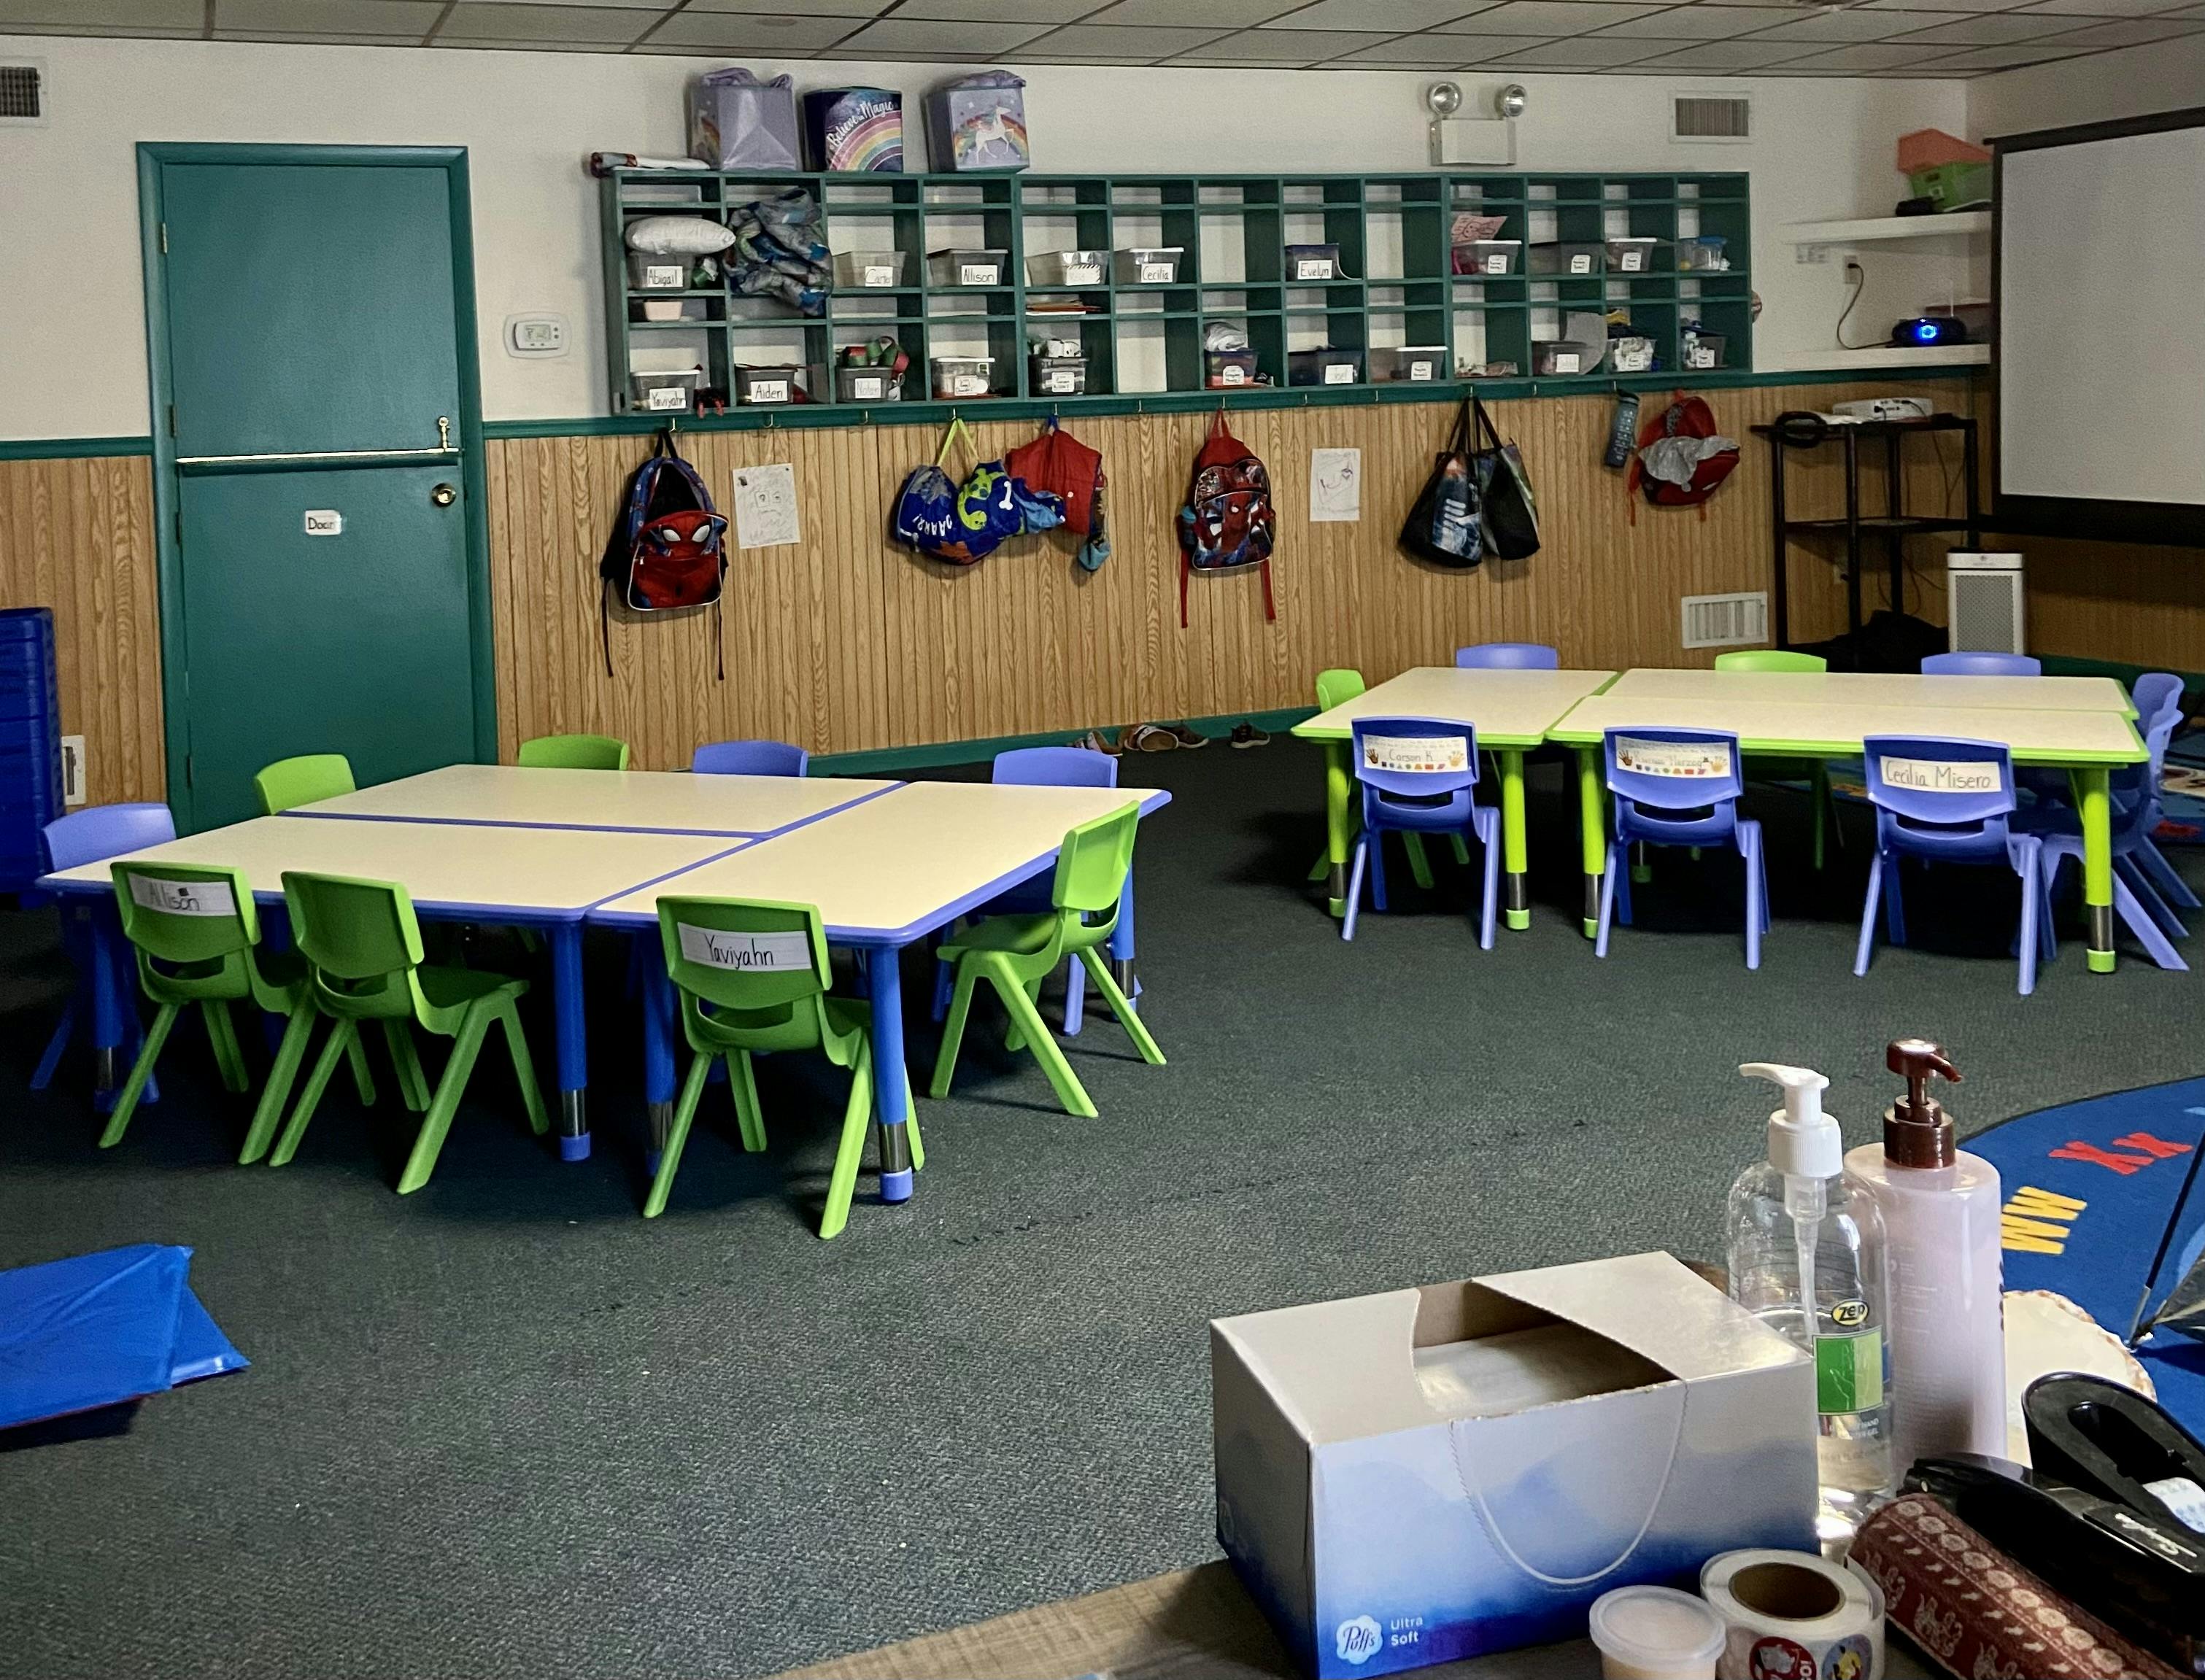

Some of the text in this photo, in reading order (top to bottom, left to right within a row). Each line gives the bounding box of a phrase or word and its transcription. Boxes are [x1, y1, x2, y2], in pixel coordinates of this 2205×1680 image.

[860, 100, 894, 119] Magic
[963, 268, 995, 283] Allison
[1143, 266, 1169, 281] Cecilia
[1301, 262, 1329, 279] Evelyn
[755, 384, 783, 400] Aiden
[1389, 749, 1421, 762] Carson
[1885, 760, 1991, 789] Cecilia Misero
[704, 933, 774, 970] Yaviyahn
[1390, 1616, 1424, 1631] Ultra
[1343, 1625, 1375, 1655] Puffs
[1390, 1630, 1419, 1646] Soft
